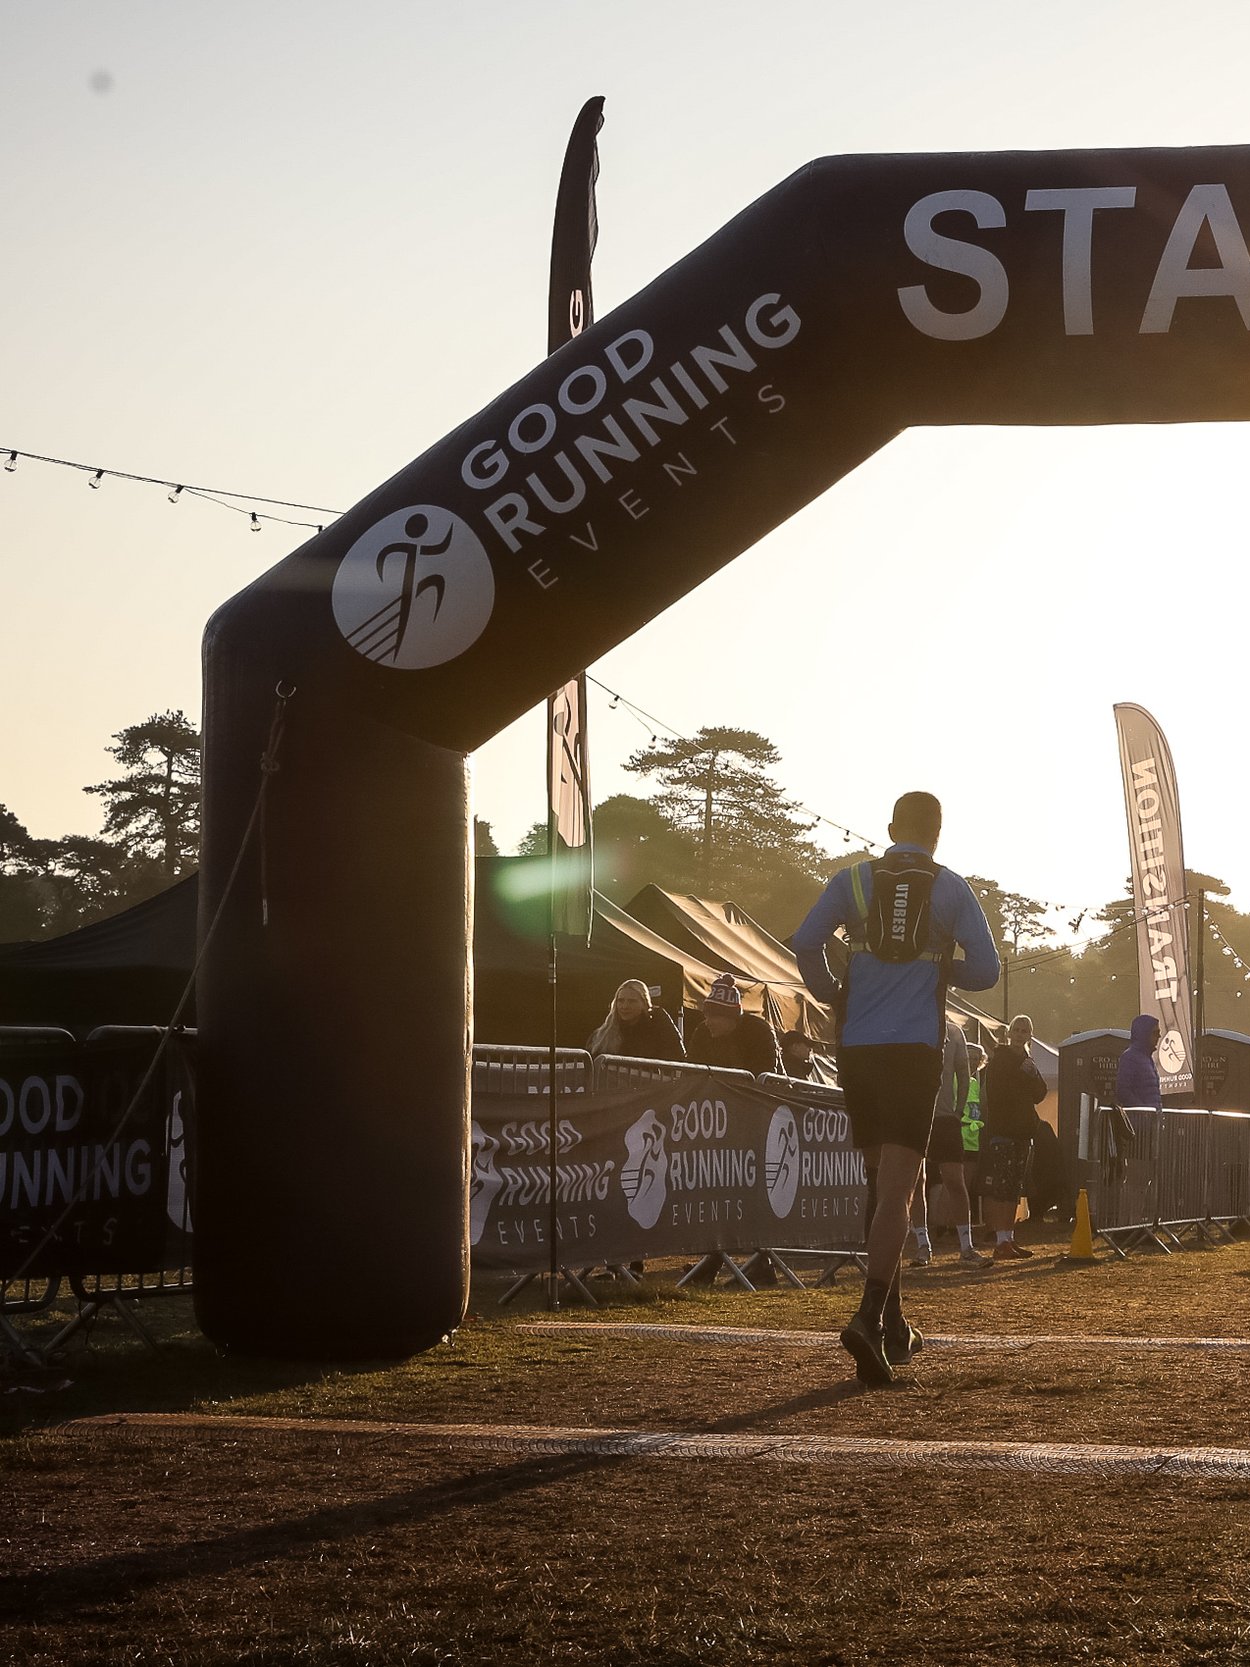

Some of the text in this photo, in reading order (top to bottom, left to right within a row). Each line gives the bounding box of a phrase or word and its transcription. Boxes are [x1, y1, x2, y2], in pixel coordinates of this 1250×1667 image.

[461, 329, 655, 490] GOOD
[483, 293, 802, 553] RUNNING
[528, 384, 786, 590] EVENTS
[892, 883, 909, 942] UTOBEST
[501, 1120, 583, 1155] GOOD
[671, 1100, 727, 1142] GOOD
[803, 1107, 849, 1142] GOOD
[498, 1160, 615, 1206] RUNNING
[670, 1149, 756, 1190] RUNNING
[672, 1199, 743, 1226] EVENTS
[801, 1197, 859, 1218] EVENTS
[498, 1213, 598, 1245] EVENTS
